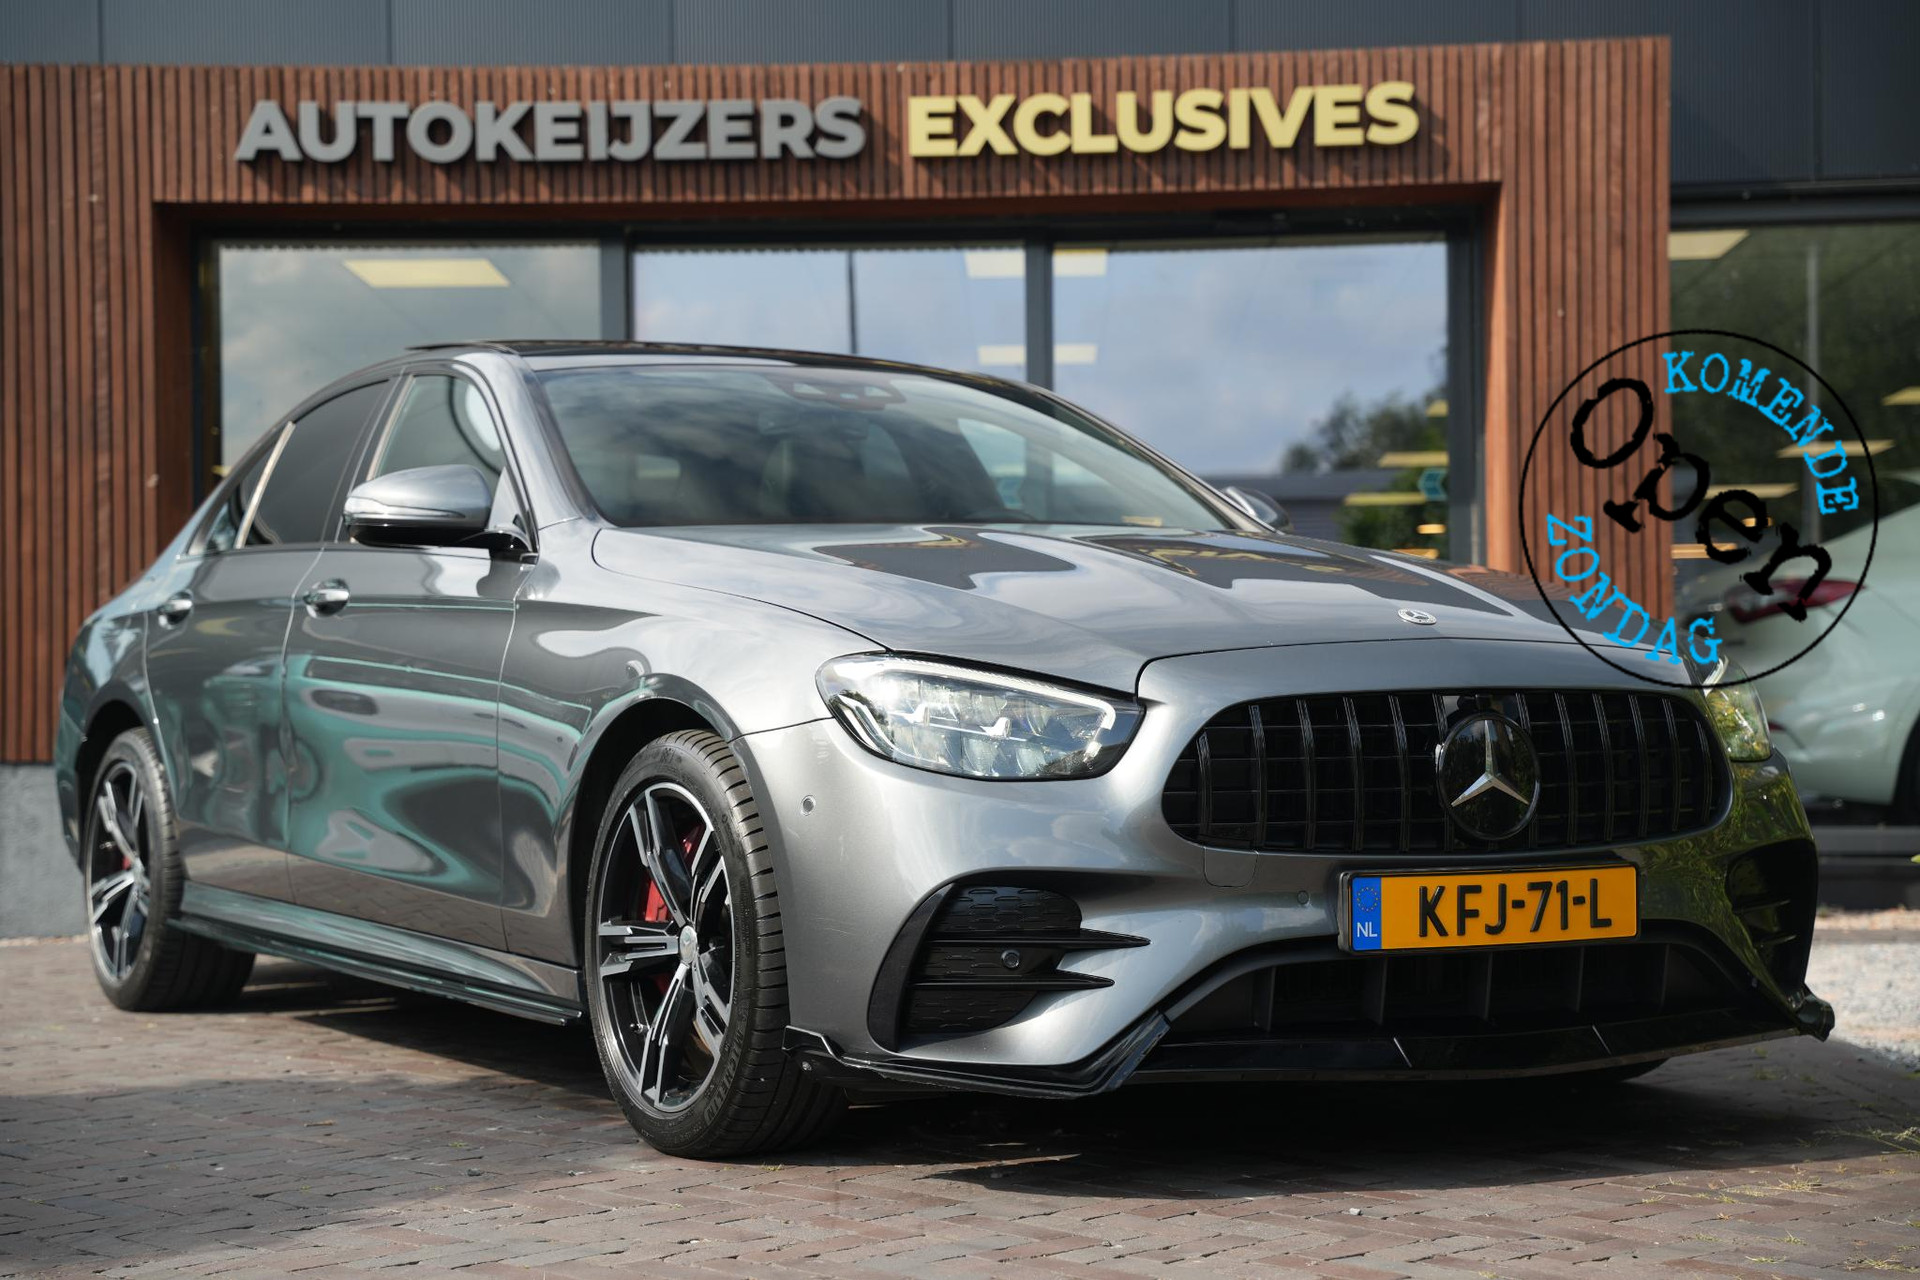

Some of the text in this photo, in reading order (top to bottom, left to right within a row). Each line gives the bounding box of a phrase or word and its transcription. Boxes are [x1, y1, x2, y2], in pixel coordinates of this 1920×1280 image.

[234, 81, 1420, 164] AUTOKEIJZERS EXCLUSIVES
[1356, 921, 1378, 938] NL
[1418, 878, 1612, 938] KFJ-71-L
